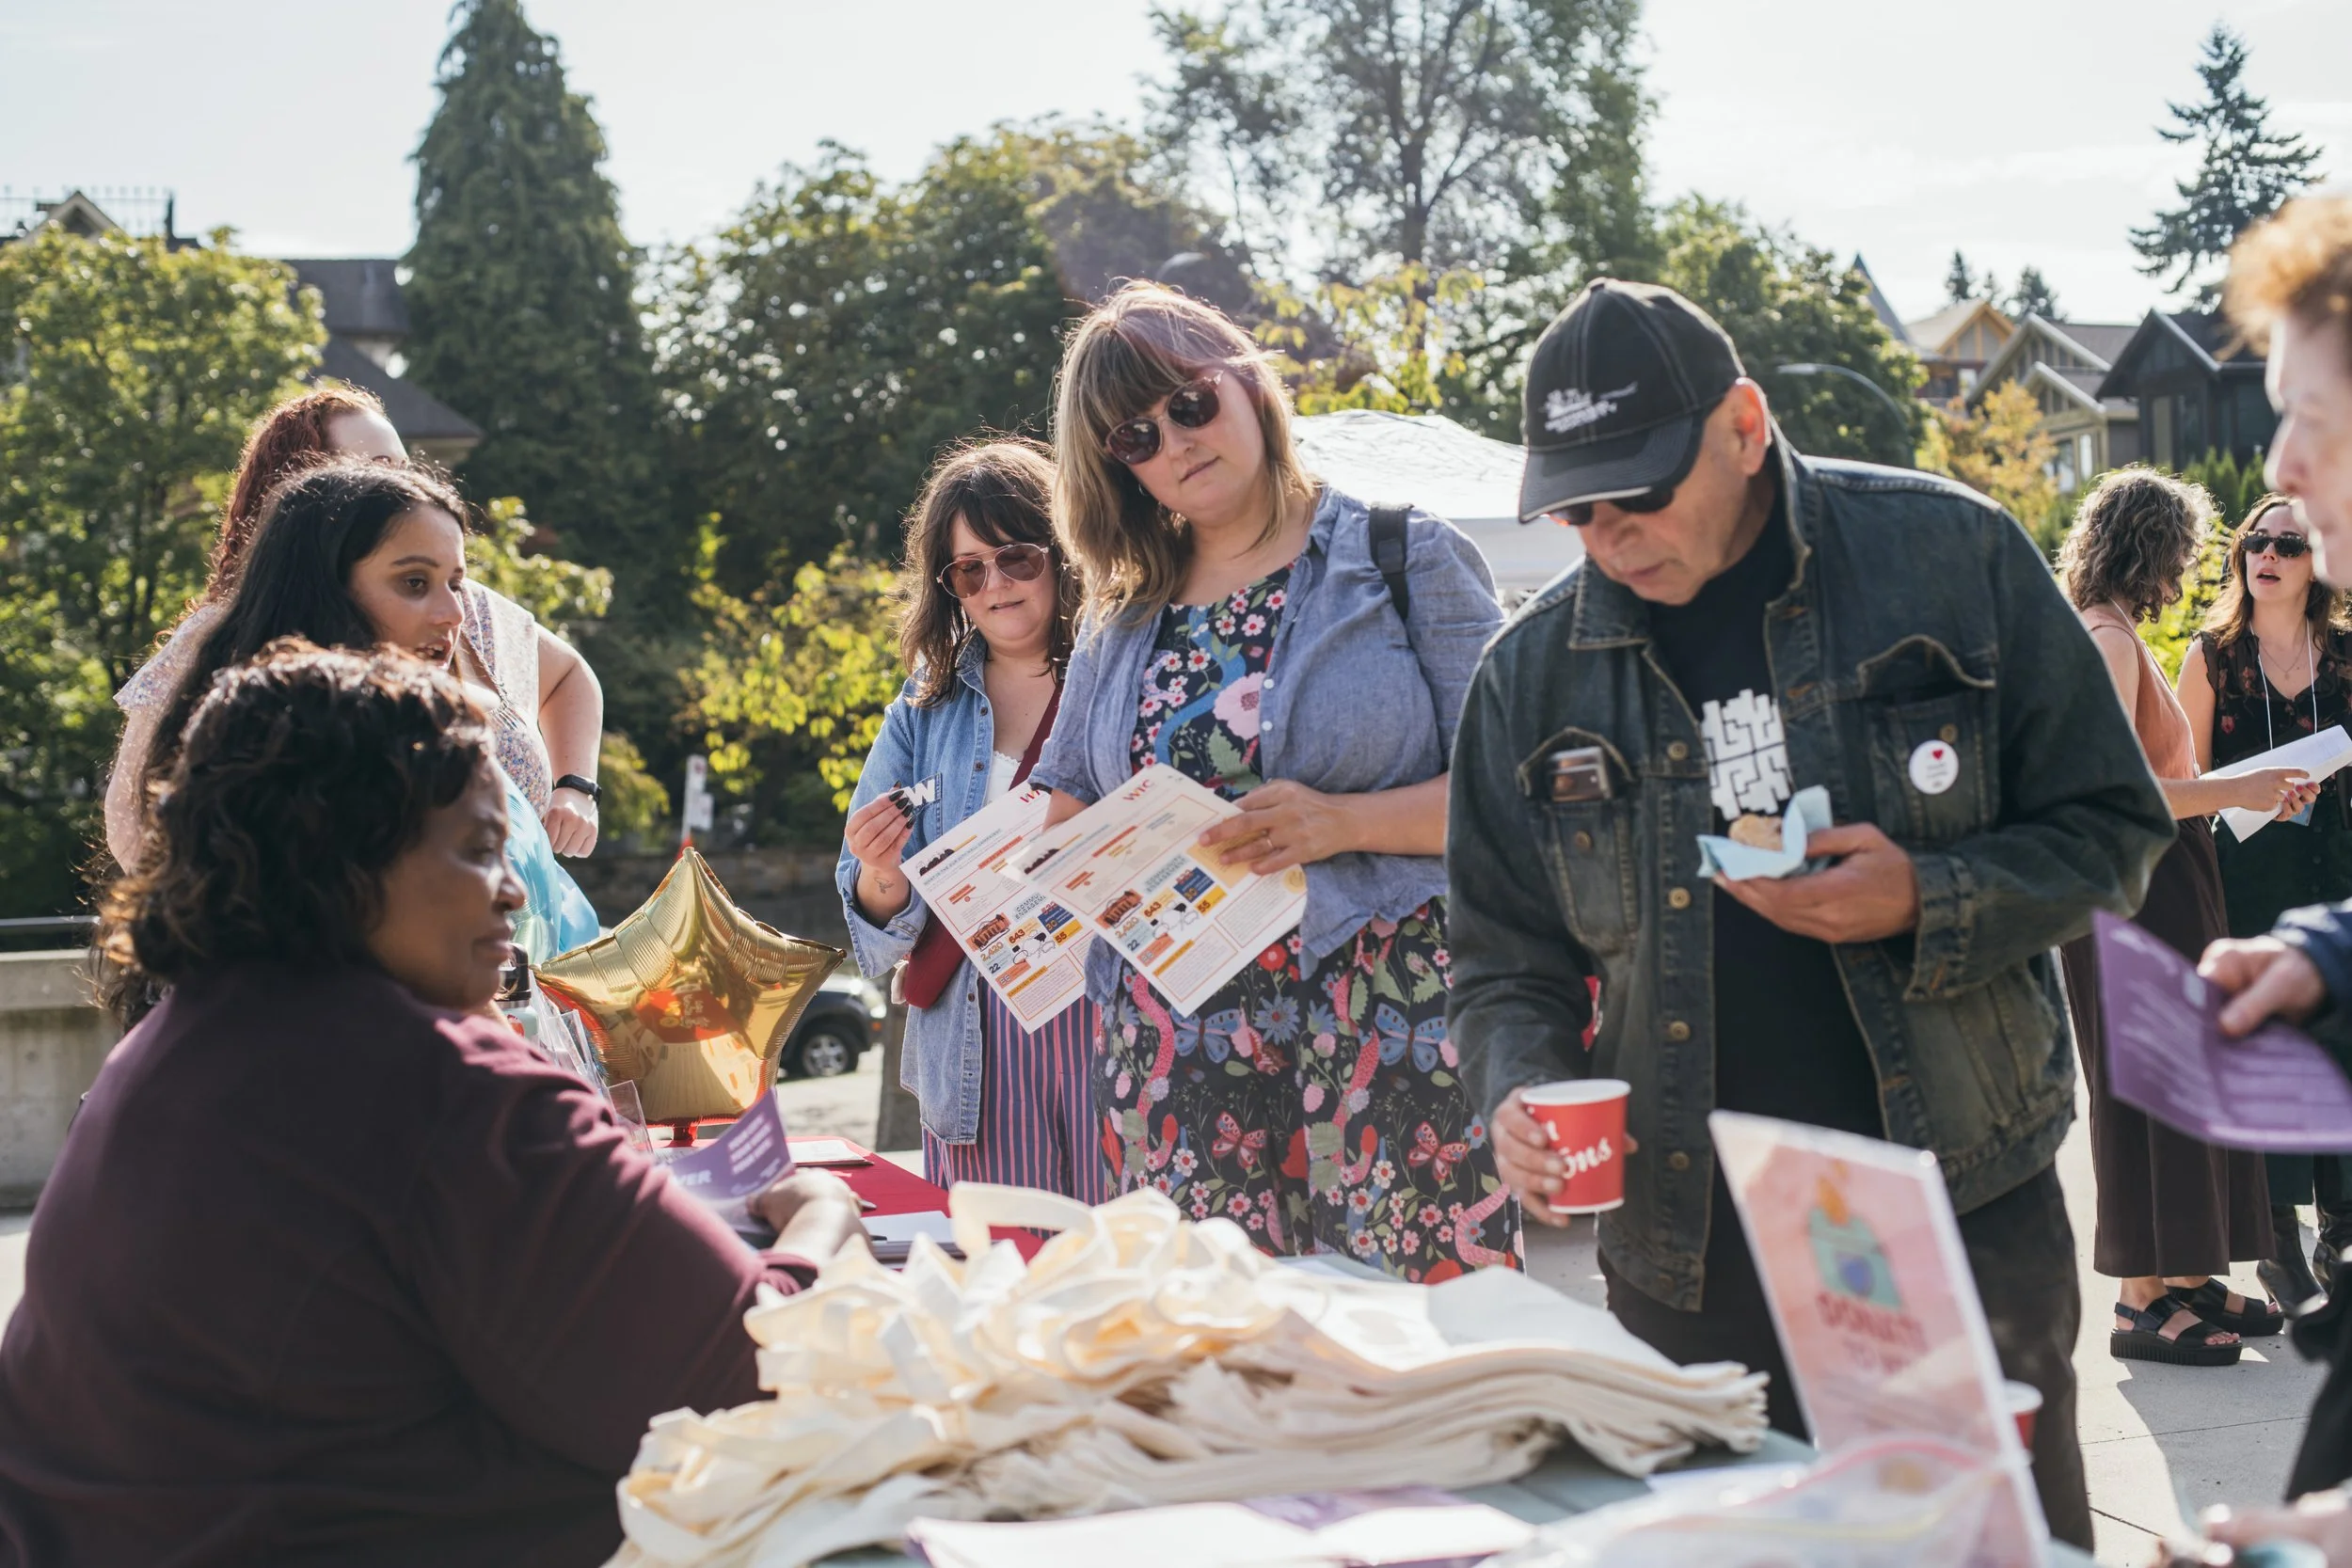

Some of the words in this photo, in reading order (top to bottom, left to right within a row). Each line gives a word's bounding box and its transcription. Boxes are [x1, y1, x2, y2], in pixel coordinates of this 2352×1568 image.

[1143, 900, 1161, 917] 643
[1197, 899, 1211, 912] 55
[1045, 919, 1057, 930] 30
[1115, 915, 1139, 939] 2,420
[1008, 927, 1025, 943] 643
[1055, 931, 1068, 943] 55
[979, 941, 1004, 961] 2,420
[1127, 939, 1139, 951] 22
[988, 962, 1000, 974] 22
